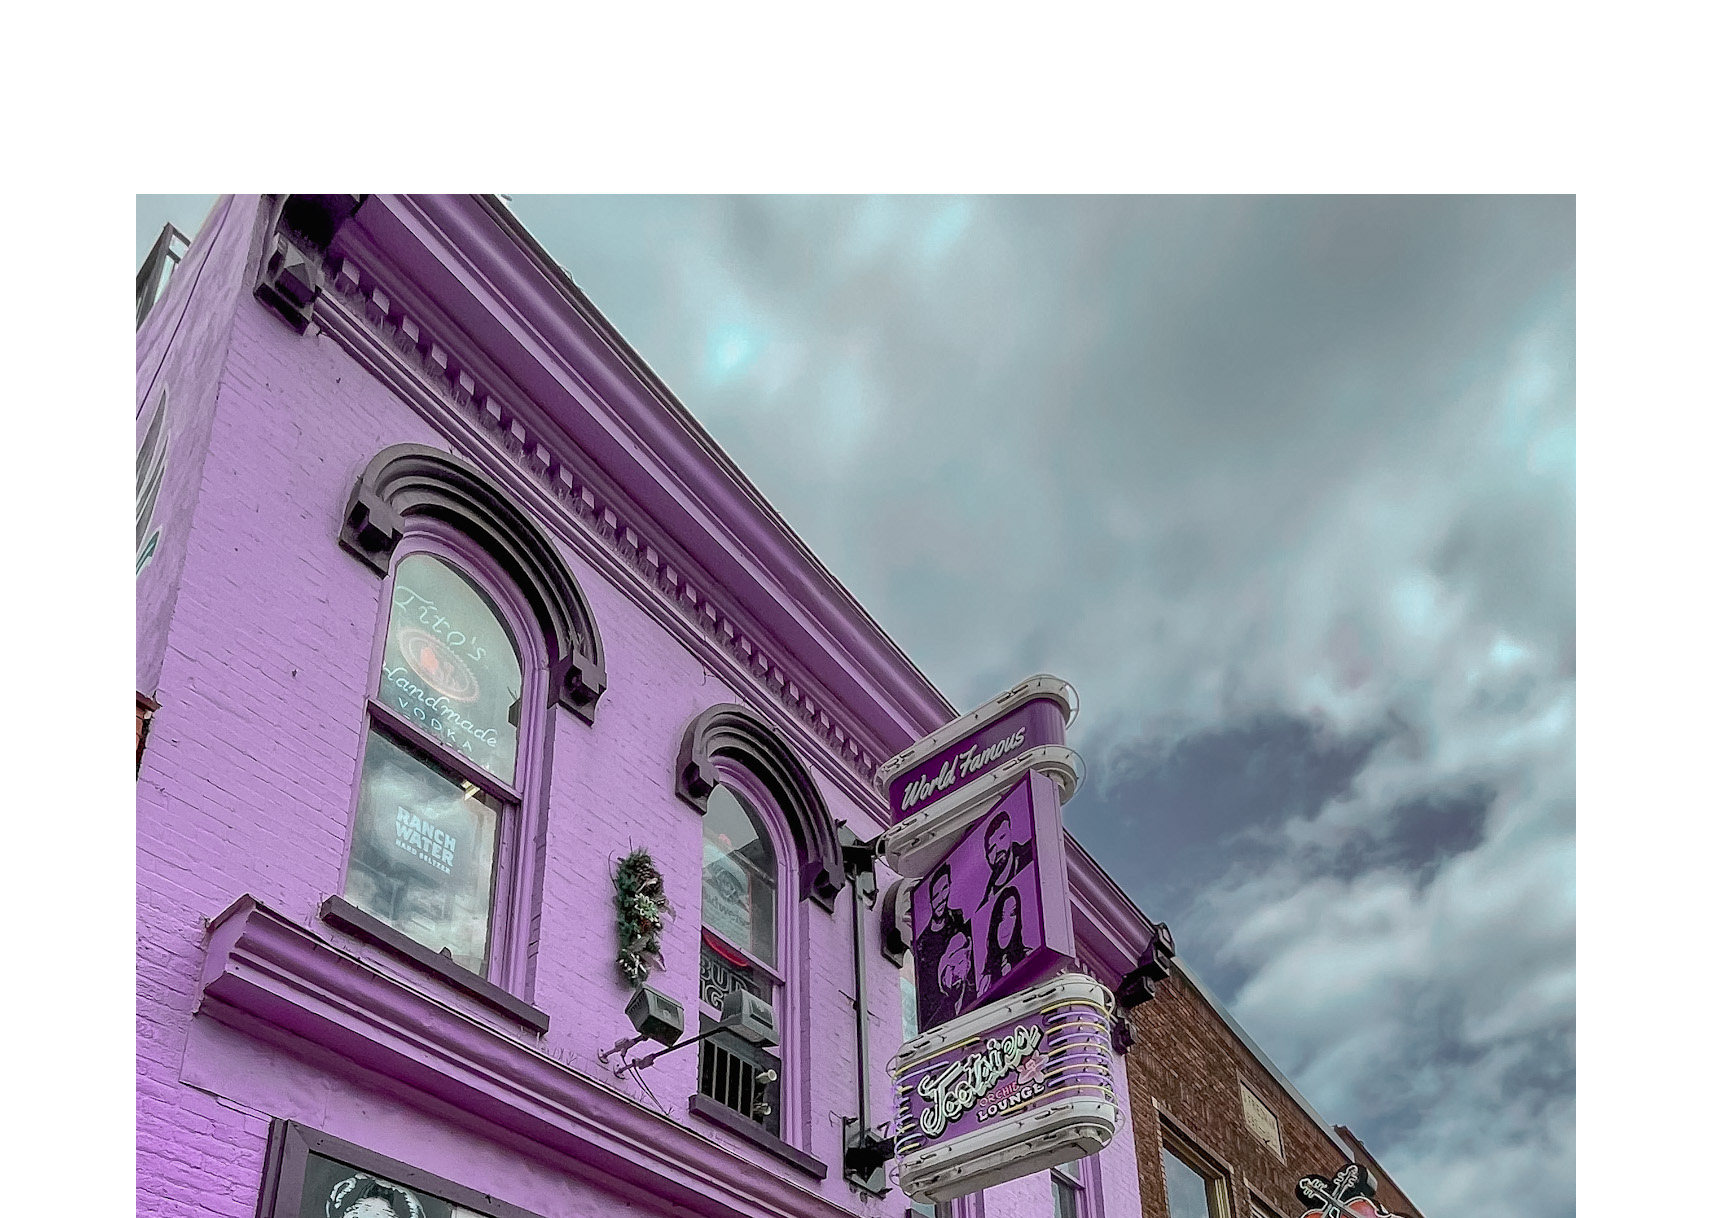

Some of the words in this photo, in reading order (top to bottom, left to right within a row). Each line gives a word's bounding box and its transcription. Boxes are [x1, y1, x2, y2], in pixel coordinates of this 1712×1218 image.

[398, 697, 473, 753] VODKA
[901, 755, 958, 812] World
[959, 726, 1026, 778] Famous
[395, 820, 454, 867] WATER
[396, 806, 456, 853] RANCH
[918, 1024, 1043, 1138] Tootsies
[977, 1082, 1045, 1122] LOUNGE
